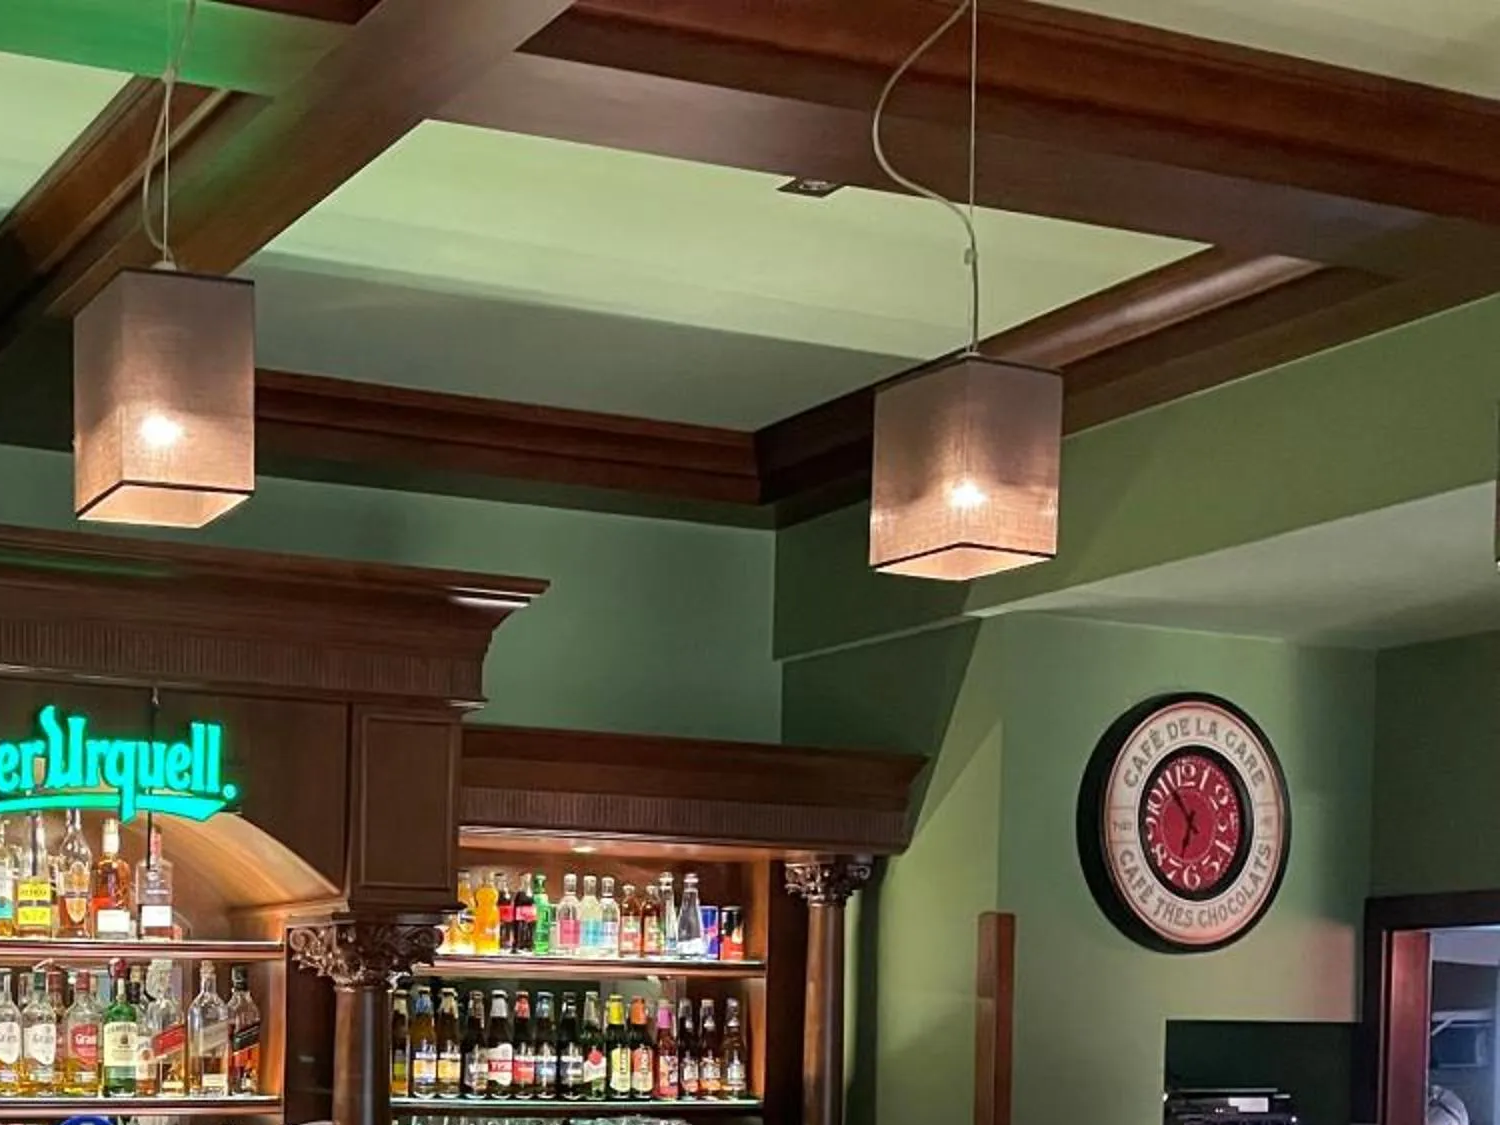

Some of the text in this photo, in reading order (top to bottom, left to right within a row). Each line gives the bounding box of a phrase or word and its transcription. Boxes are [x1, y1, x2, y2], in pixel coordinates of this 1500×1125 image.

[1166, 717, 1191, 743] DE
[1195, 718, 1222, 742] LA
[1224, 730, 1267, 789] GARE
[1198, 843, 1272, 929] CHOCOLATS
